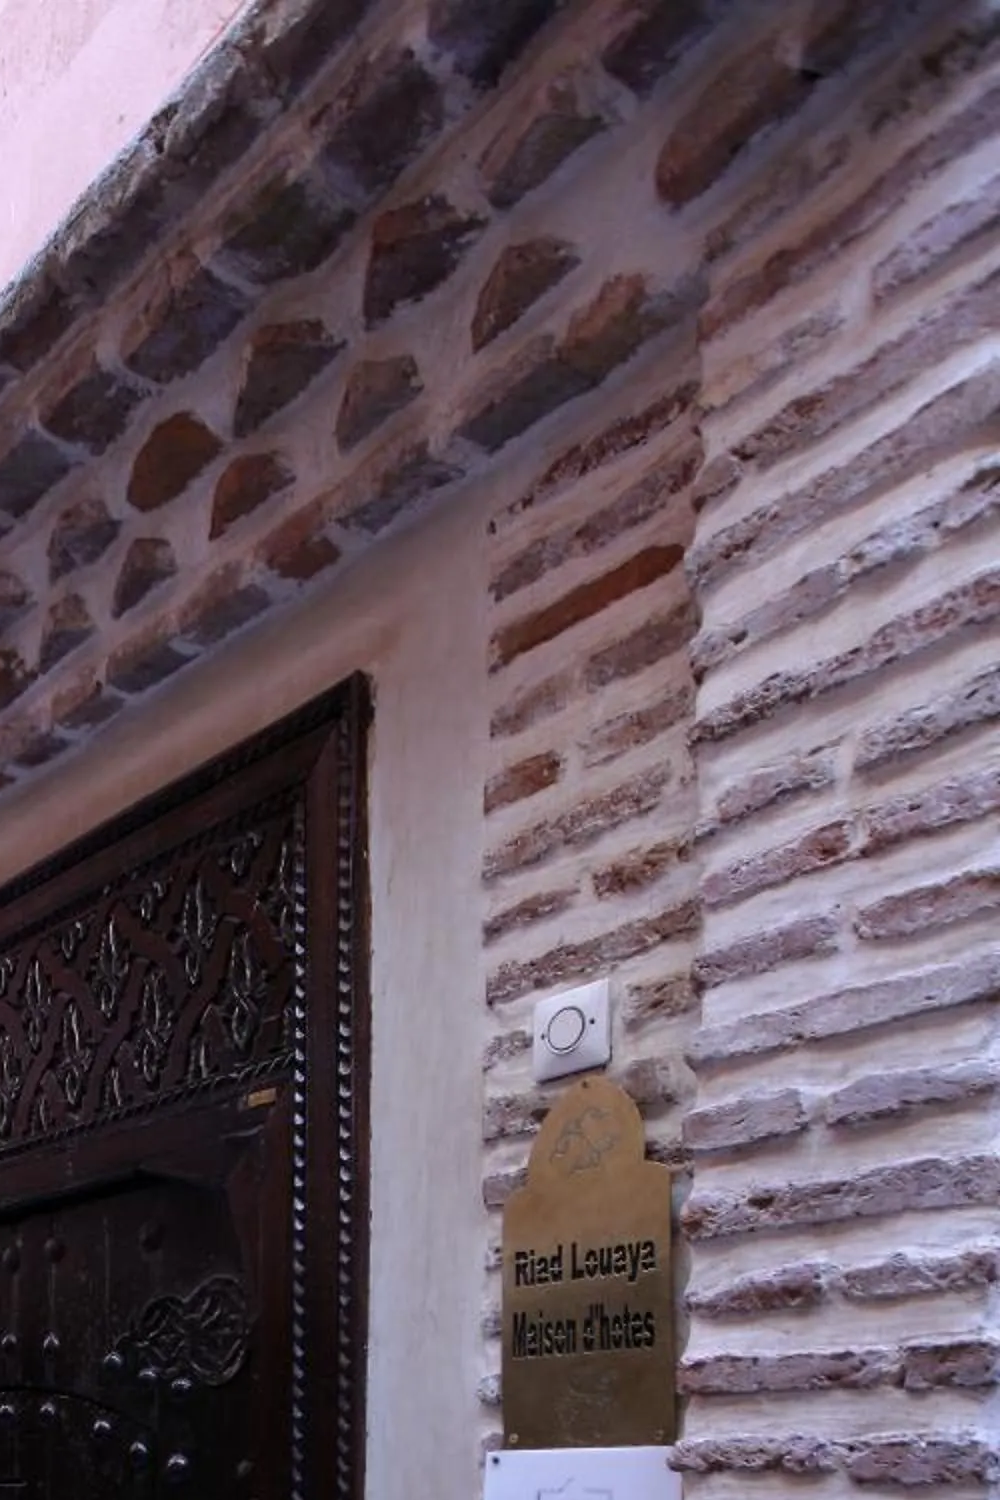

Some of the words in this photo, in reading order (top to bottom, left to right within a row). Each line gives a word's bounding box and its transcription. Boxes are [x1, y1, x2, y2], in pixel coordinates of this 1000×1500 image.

[514, 1245, 563, 1286] Riad
[571, 1240, 656, 1283] Louaya
[512, 1310, 577, 1357] Maison
[583, 1304, 655, 1352] d'hotes
